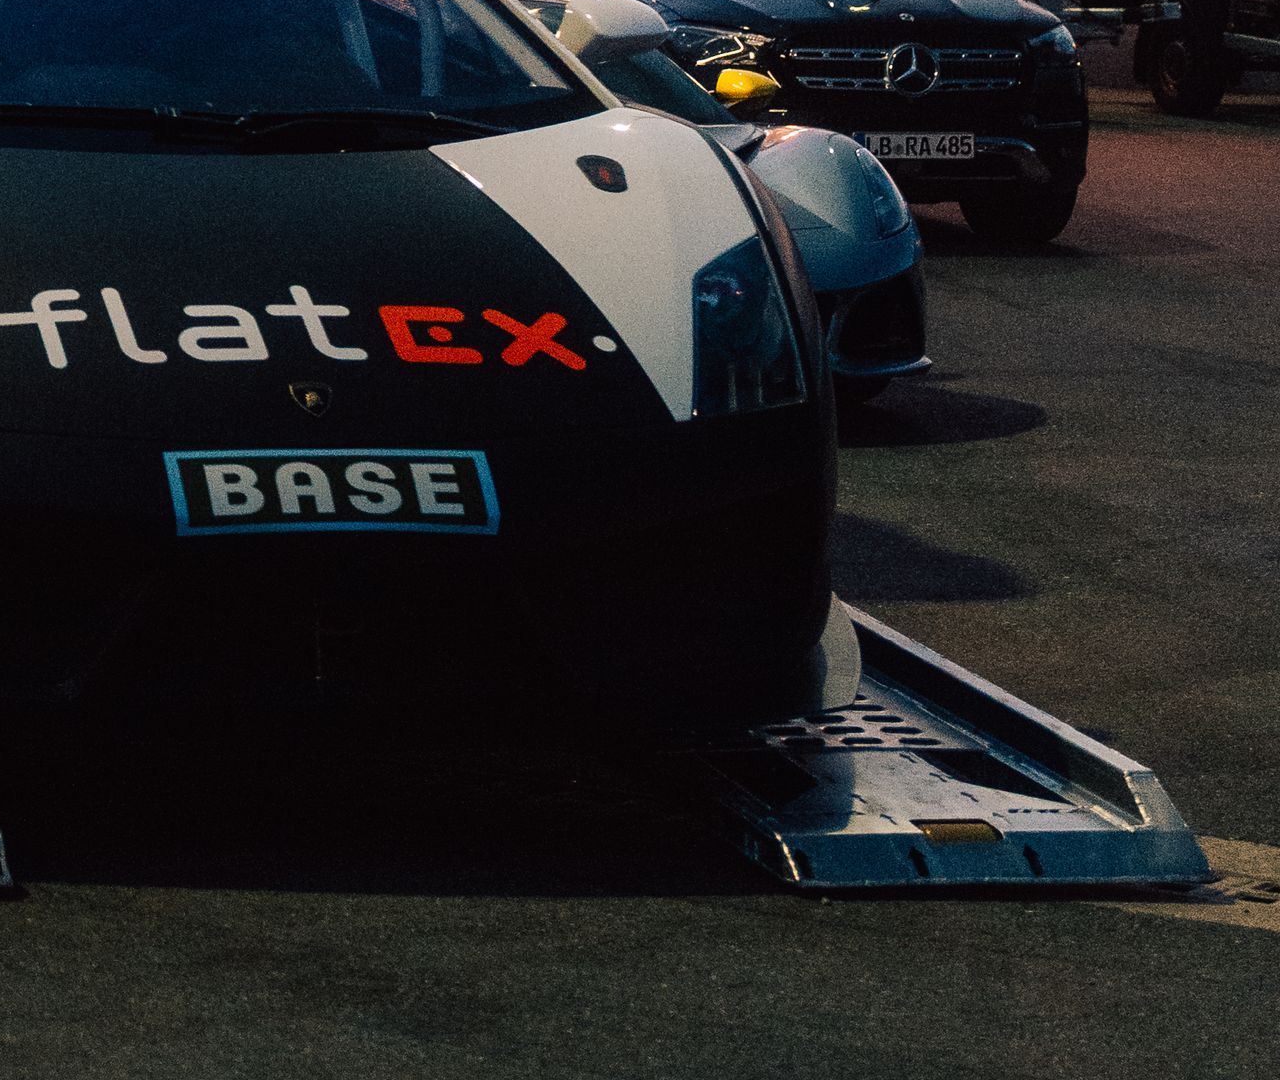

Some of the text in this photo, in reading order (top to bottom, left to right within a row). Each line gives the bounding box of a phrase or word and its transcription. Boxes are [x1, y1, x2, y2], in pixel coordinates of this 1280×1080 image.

[906, 136, 932, 156] RA
[936, 135, 973, 156] 485
[202, 461, 466, 517] BASE
